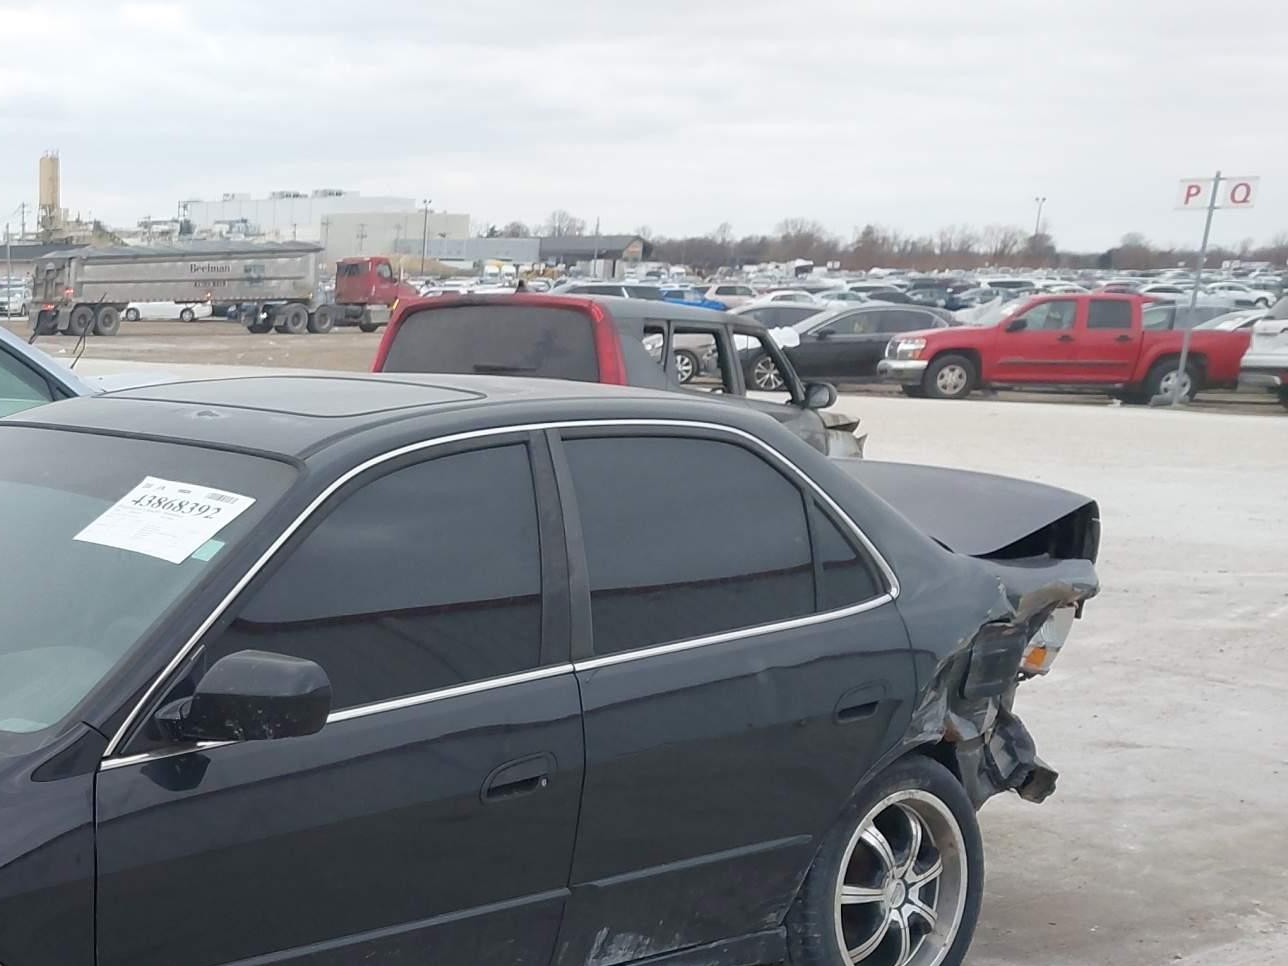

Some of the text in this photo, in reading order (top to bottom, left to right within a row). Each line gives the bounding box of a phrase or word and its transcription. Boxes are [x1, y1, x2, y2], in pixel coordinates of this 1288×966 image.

[1184, 184, 1201, 205] P
[1230, 182, 1251, 204] Q
[190, 263, 231, 273] Beelman
[132, 495, 222, 519] 43868392
